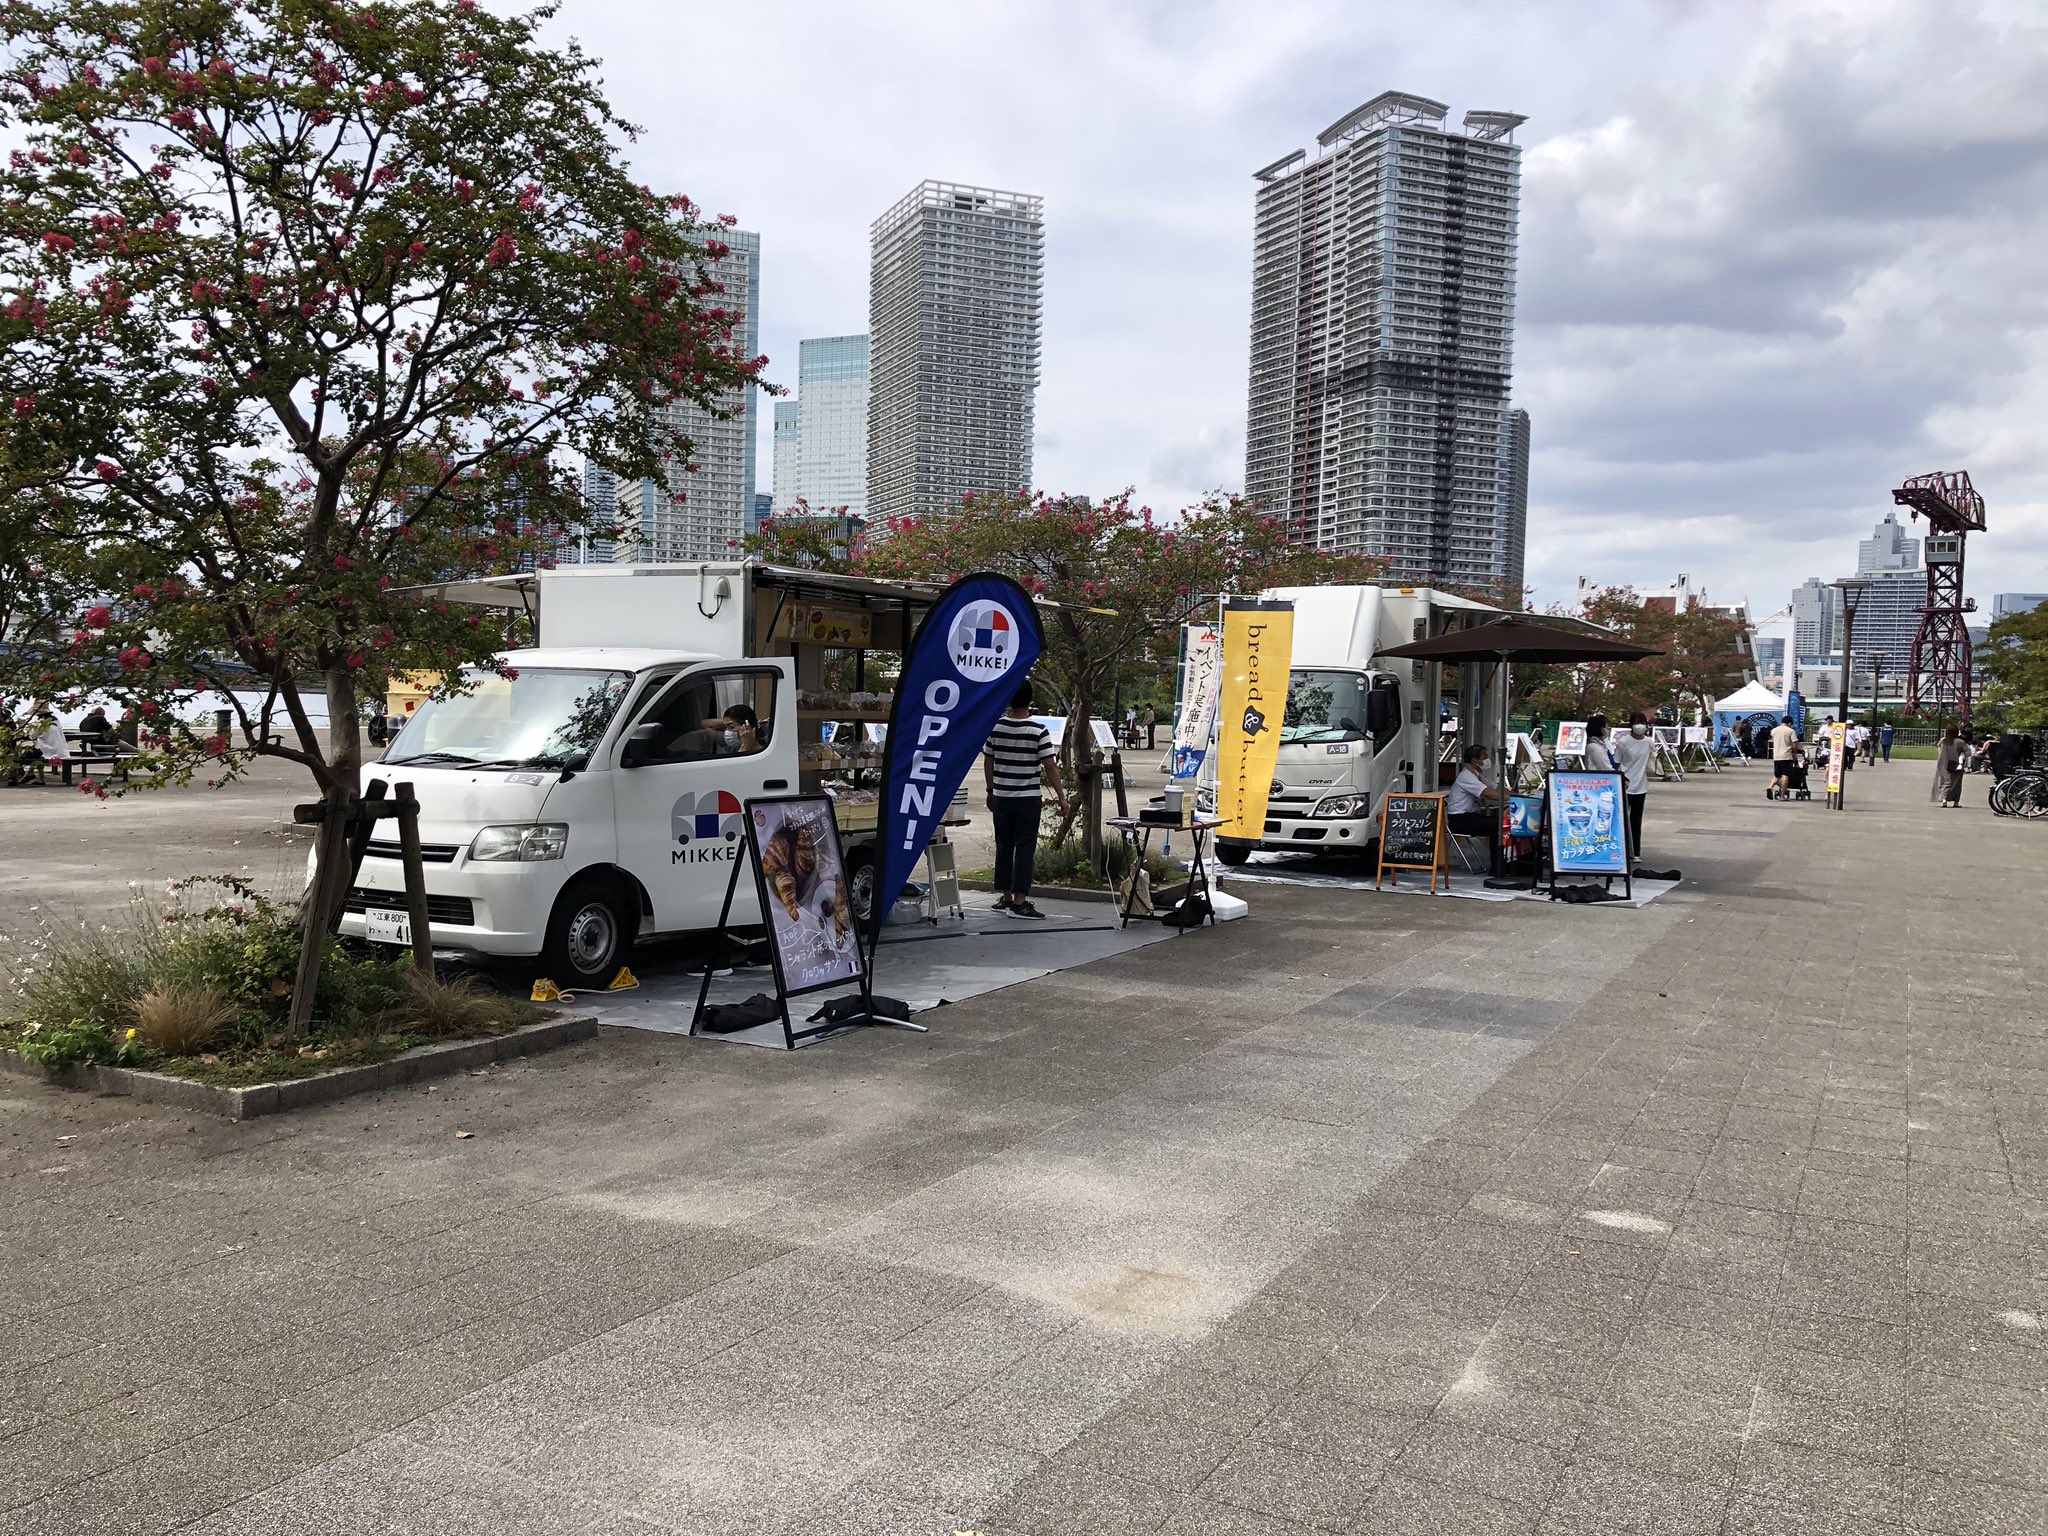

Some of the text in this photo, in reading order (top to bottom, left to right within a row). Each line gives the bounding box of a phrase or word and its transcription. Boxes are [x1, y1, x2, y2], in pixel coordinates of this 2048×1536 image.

[956, 653, 1008, 670] MIKKE!
[1236, 623, 1267, 826] bread & butter
[1328, 745, 1347, 754] A-18
[899, 678, 960, 850] OPEN!
[509, 774, 538, 784] B-2
[1391, 819, 1432, 828] ラクトフェリン
[1561, 842, 1618, 860] カラダ強くする
